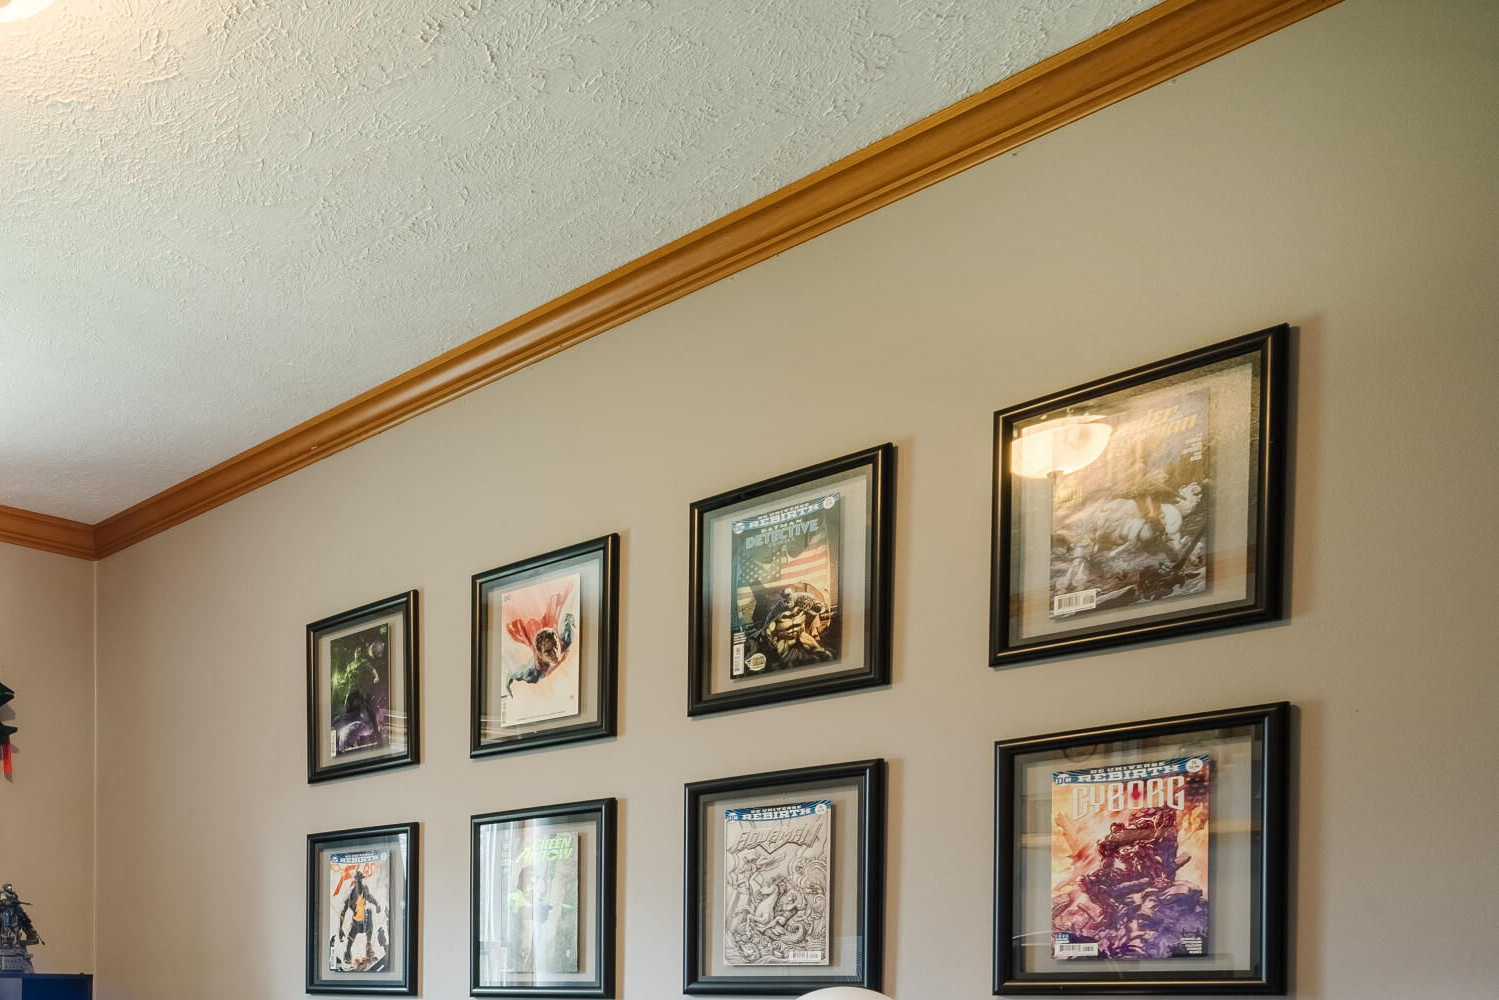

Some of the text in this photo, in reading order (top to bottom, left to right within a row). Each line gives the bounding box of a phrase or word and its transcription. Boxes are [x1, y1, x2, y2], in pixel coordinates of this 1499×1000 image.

[748, 502, 821, 528] REBIRTH
[745, 518, 819, 550] DETECTIVE
[761, 518, 803, 534] BATMAN
[1077, 764, 1181, 783] REBIRTH
[1107, 761, 1166, 773] UNIVERSE
[1072, 775, 1185, 821] CYBORG
[742, 807, 811, 820] REBIRTH
[533, 836, 572, 850] GREEN
